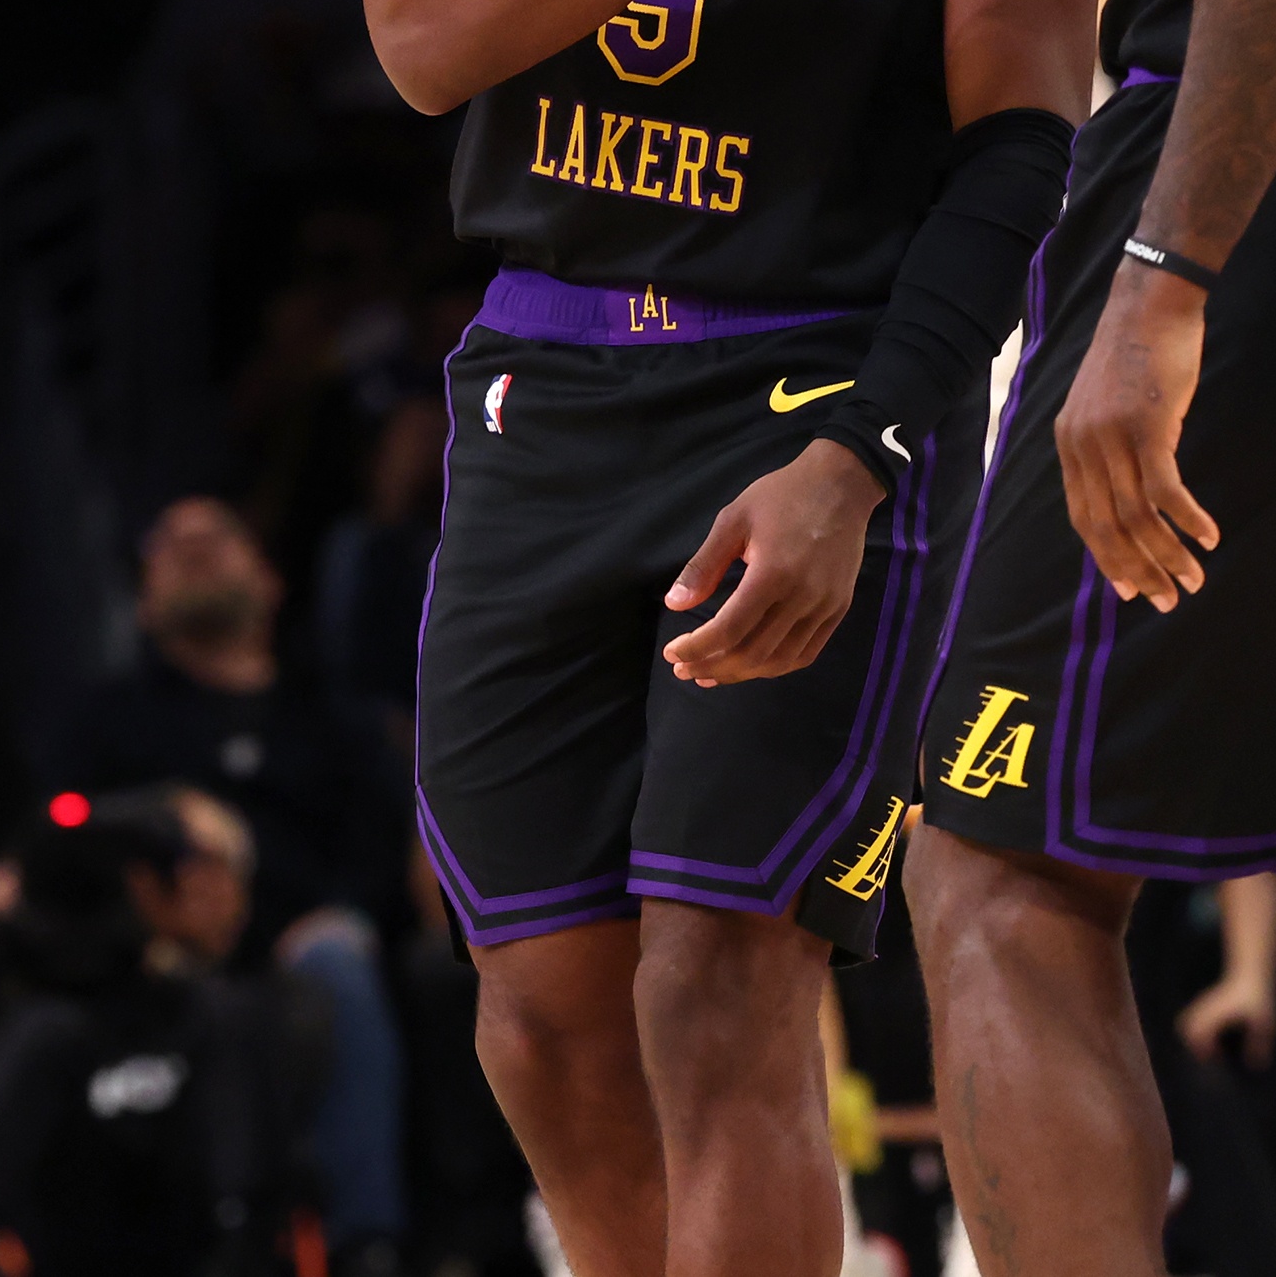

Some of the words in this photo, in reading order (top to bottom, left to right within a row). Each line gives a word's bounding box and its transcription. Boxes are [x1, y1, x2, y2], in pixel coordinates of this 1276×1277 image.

[530, 96, 751, 214] LAKERS
[628, 283, 677, 332] LAL
[939, 684, 1036, 799] LA
